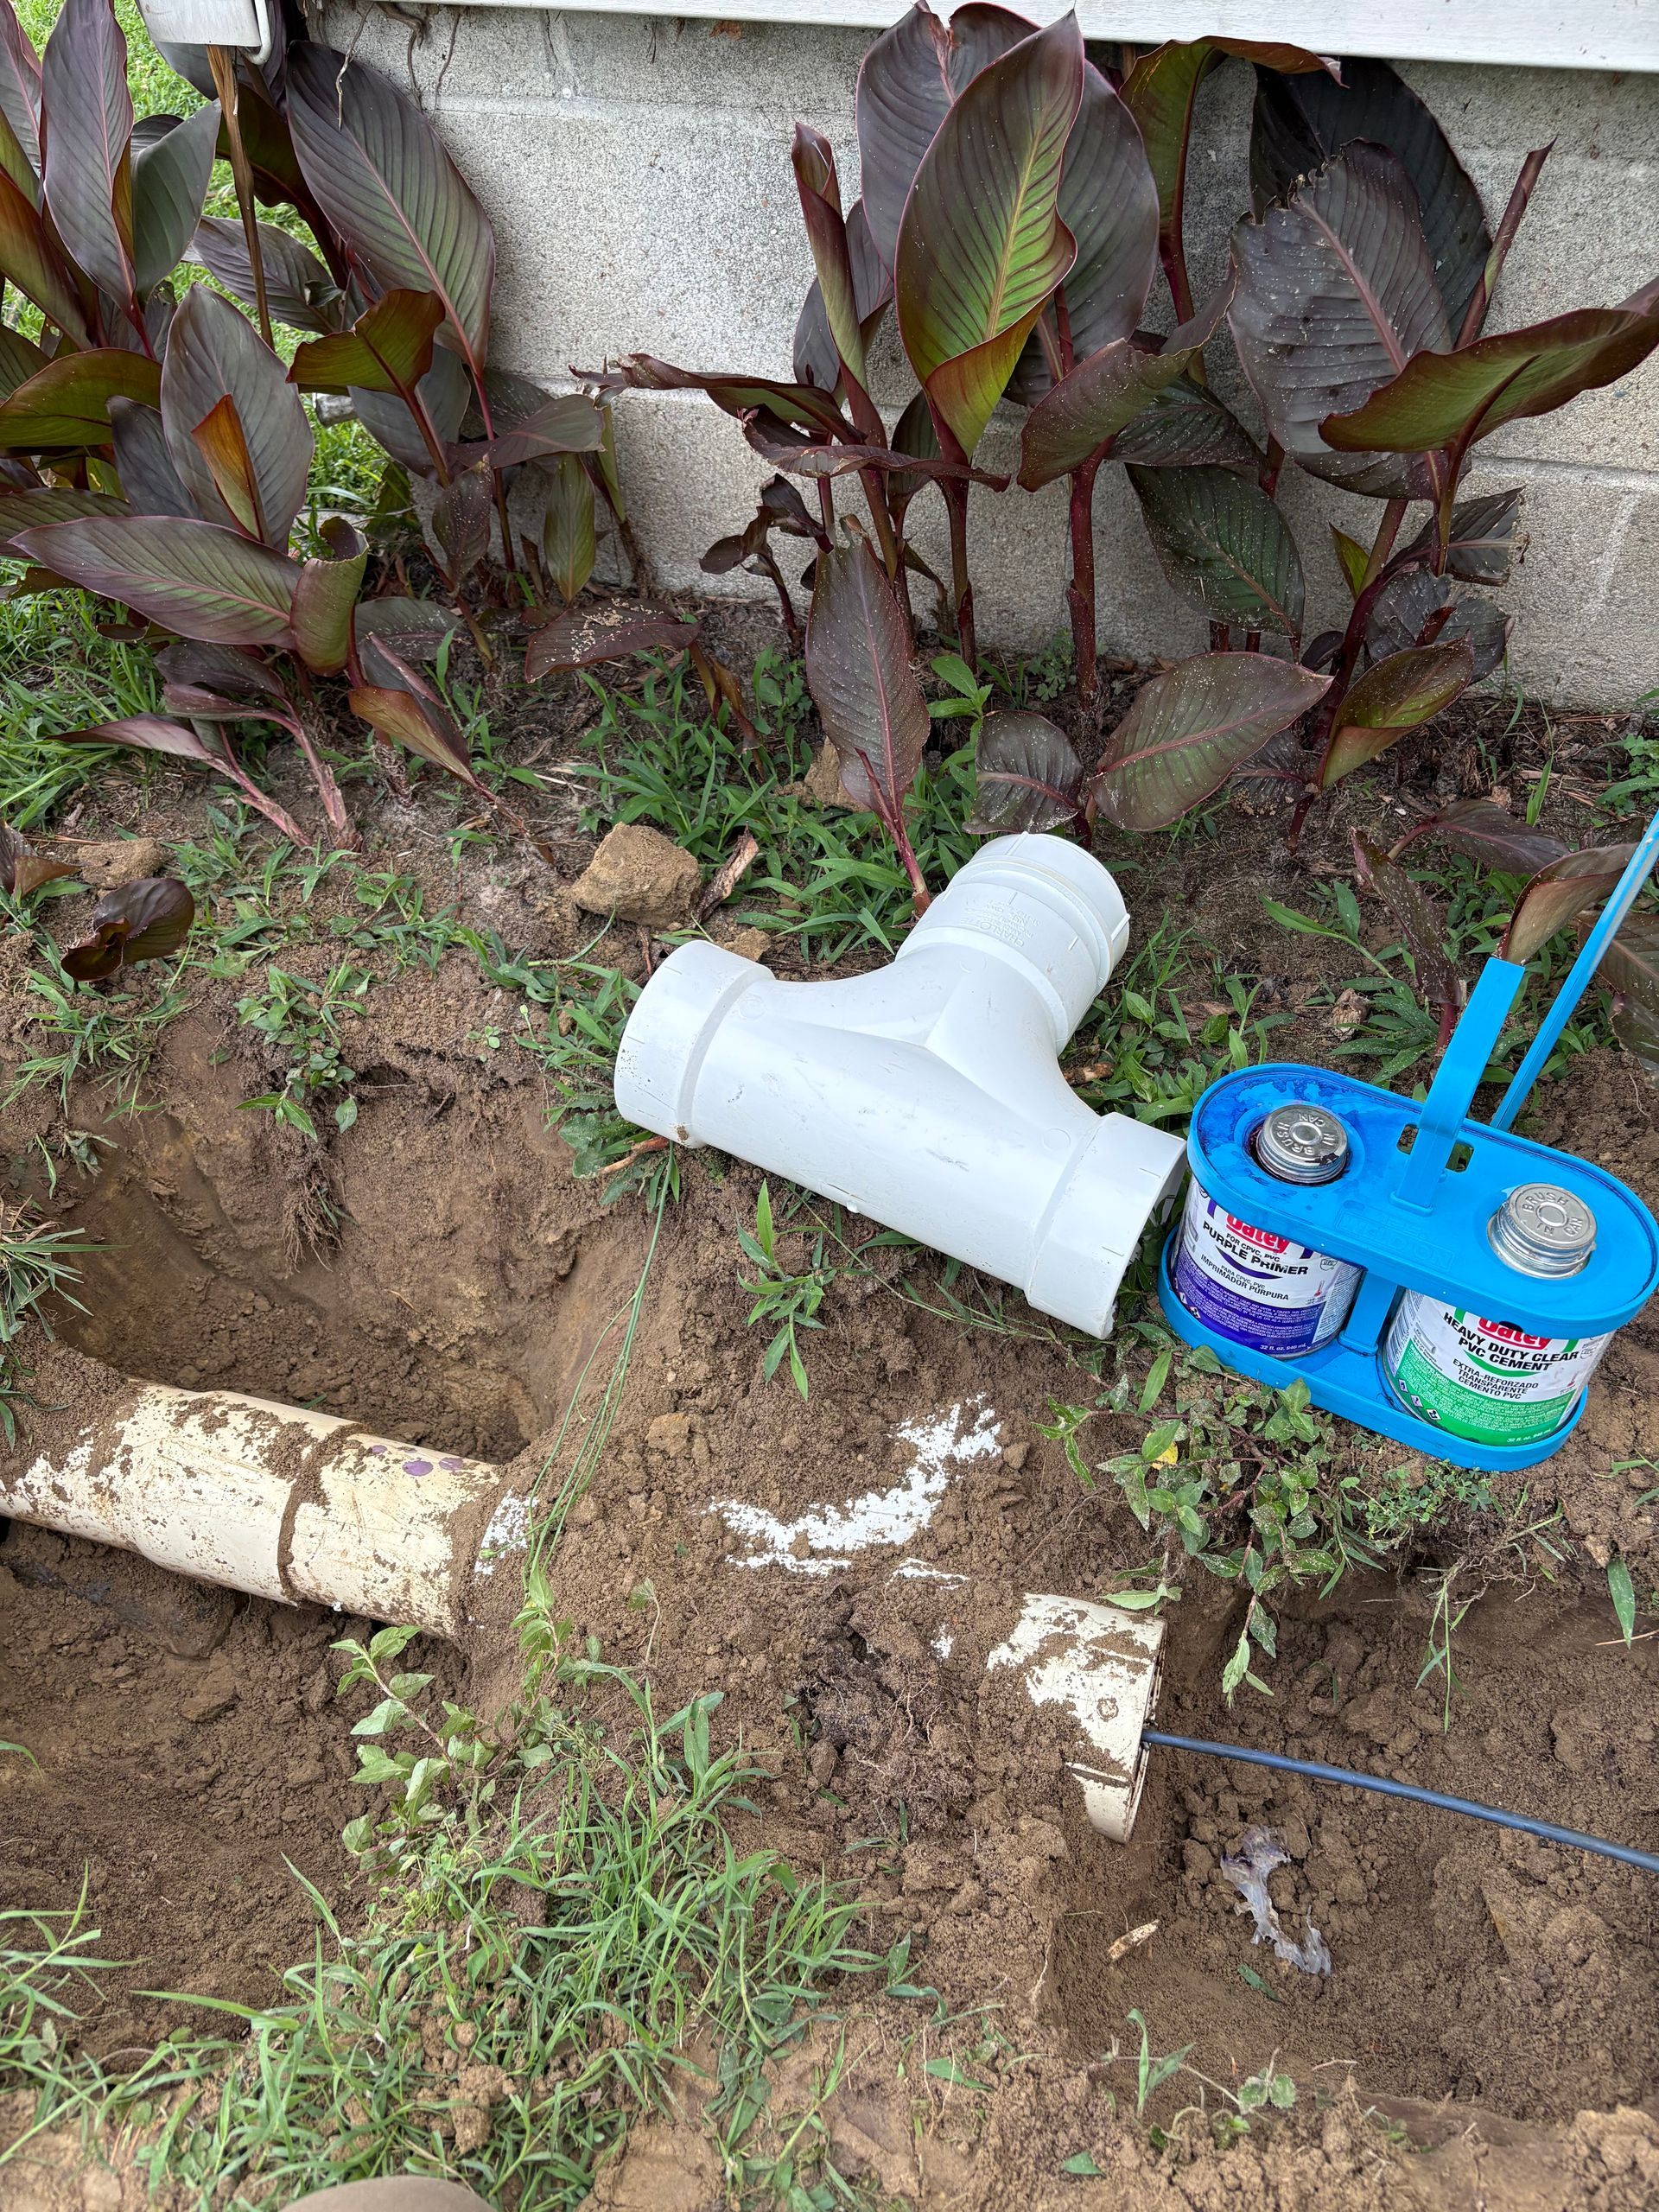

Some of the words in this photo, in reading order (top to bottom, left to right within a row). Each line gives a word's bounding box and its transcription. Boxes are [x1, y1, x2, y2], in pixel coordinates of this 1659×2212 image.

[1299, 1113, 1325, 1127] CAN
[1276, 1122, 1314, 1155] BRUSH
[1322, 1133, 1335, 1146] IN
[1522, 1192, 1568, 1213] BRUSH
[1536, 1222, 1554, 1236] IN
[1563, 1217, 1583, 1236] CAN
[1203, 1220, 1249, 1261] PURPLE
[1251, 1256, 1309, 1275] PRIMER
[1226, 1233, 1240, 1245] FOR
[1242, 1243, 1262, 1257] CPVC,
[1201, 1254, 1248, 1289] IMPRIMADOR
[1249, 1285, 1289, 1300] PURPURA
[1221, 1265, 1235, 1276] PARA
[1443, 1312, 1485, 1345] HEAVY
[1488, 1342, 1532, 1360] DUTY
[1531, 1351, 1580, 1363] CLEAR
[1459, 1337, 1486, 1357] PVC
[1490, 1354, 1553, 1371] CEMENT
[1452, 1358, 1539, 1389] EXTRA-REFORZADO
[1459, 1369, 1529, 1395] TRANSPARENTE
[1459, 1376, 1501, 1396] CEMENTO
